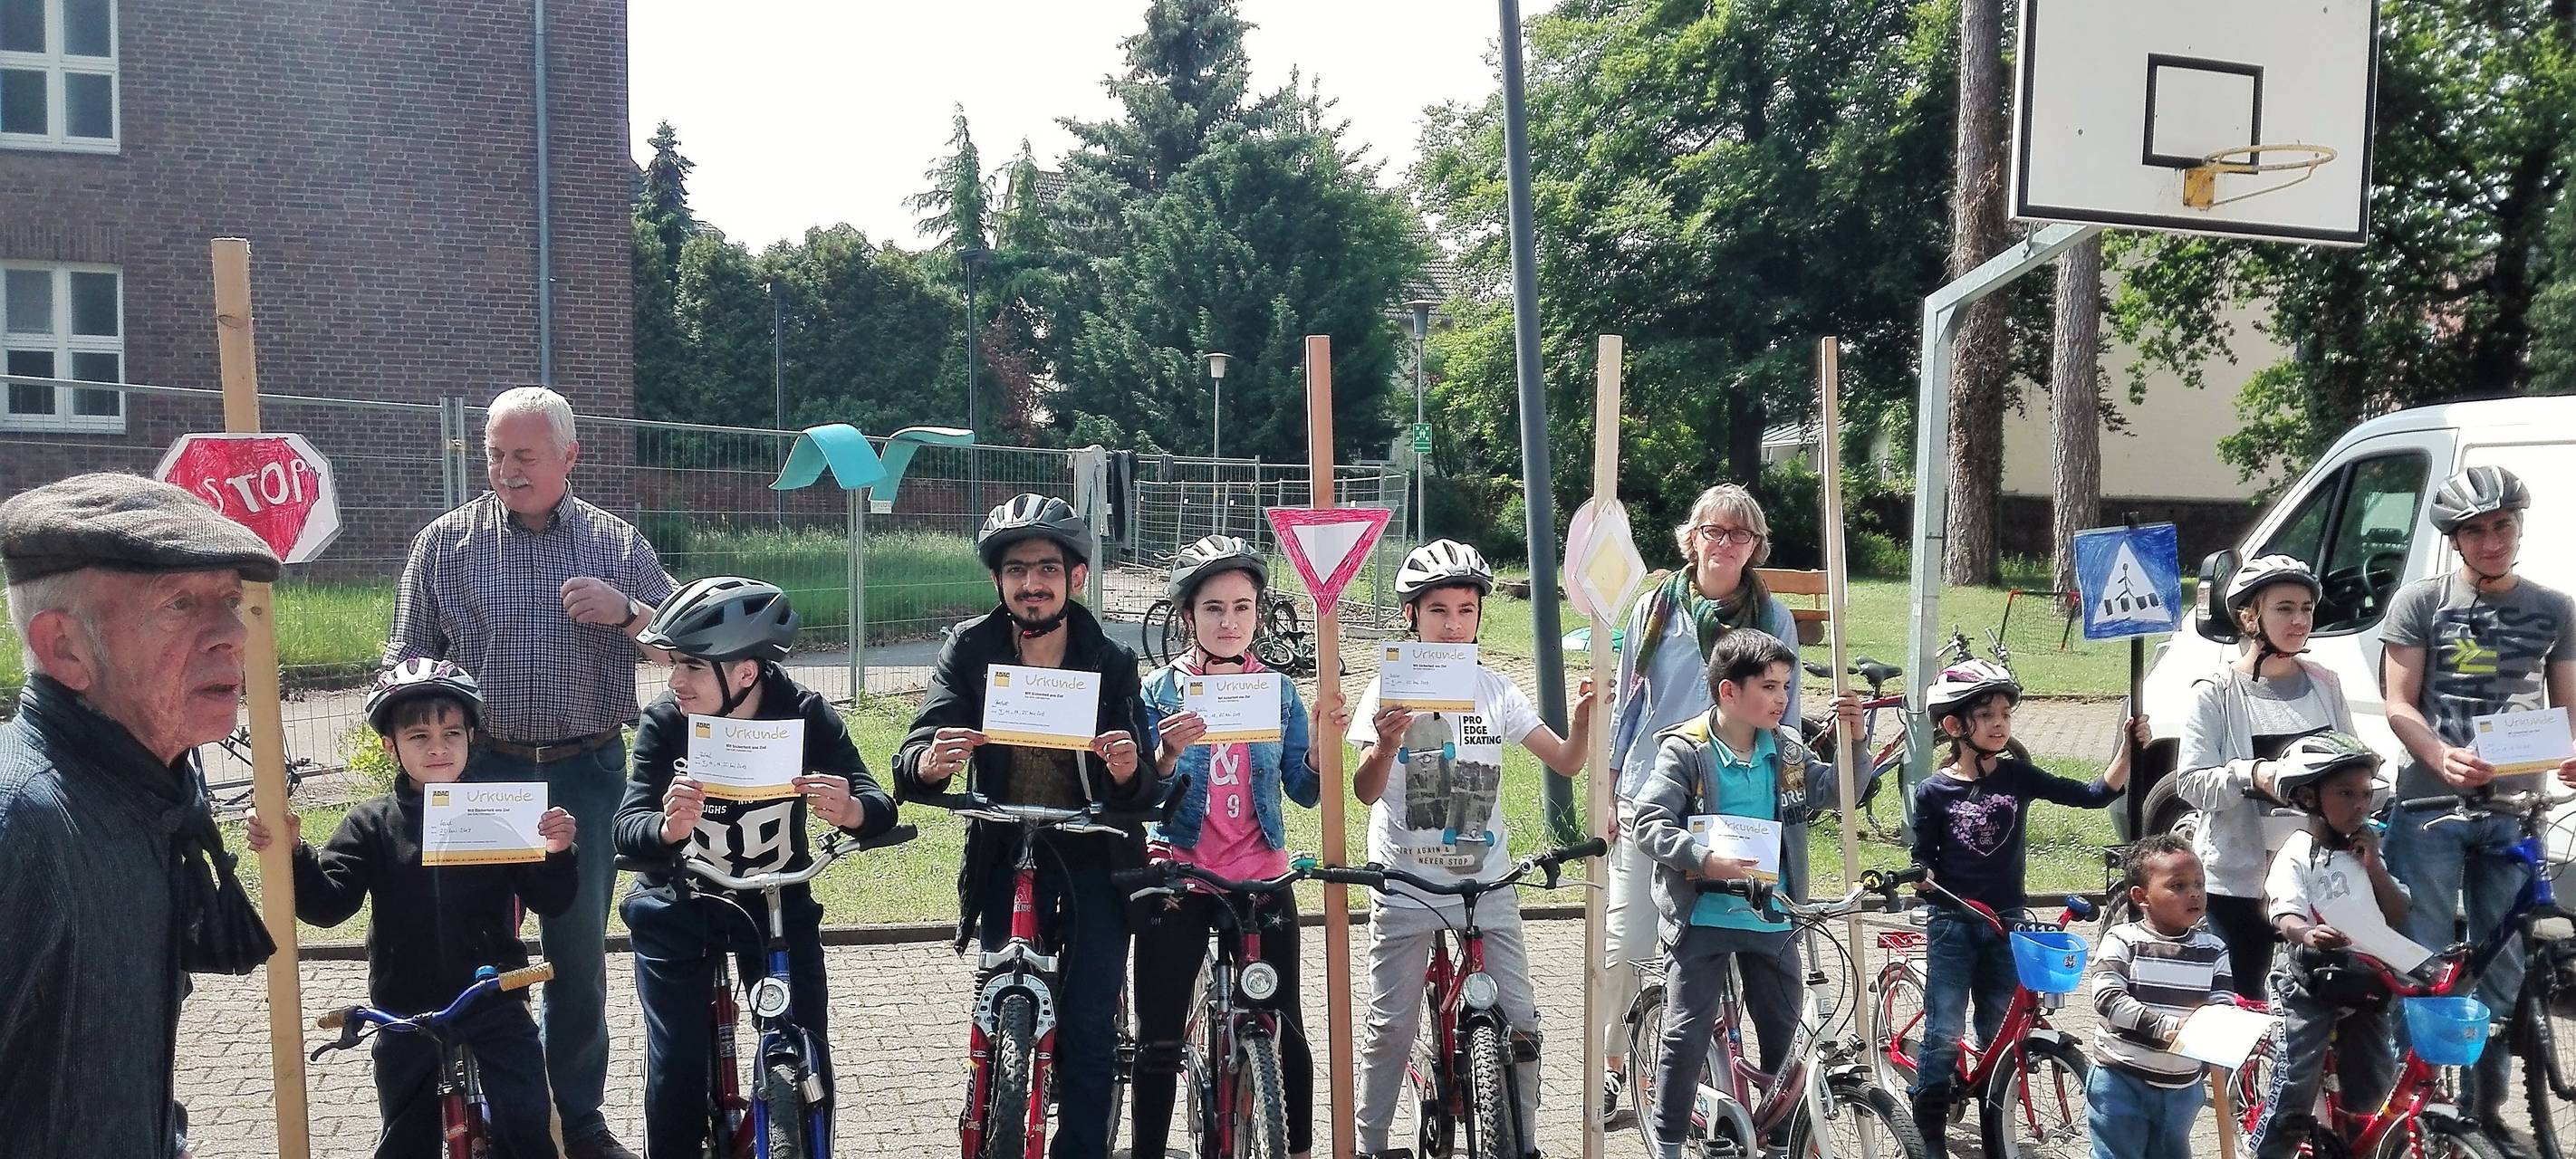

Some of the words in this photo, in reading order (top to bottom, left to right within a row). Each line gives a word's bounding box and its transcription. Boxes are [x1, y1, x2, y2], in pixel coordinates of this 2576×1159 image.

[202, 458, 305, 514] STOP
[1413, 648, 1466, 660] Urkunde
[1025, 675, 1087, 689] Urkunde
[1216, 679, 1269, 692] Urkunde
[1463, 715, 1483, 724] PRO
[726, 727, 790, 740] Urkunde
[1464, 725, 1488, 735] EDGE
[1464, 735, 1502, 745] SKATING
[467, 789, 534, 802] Urkunde
[1725, 820, 1769, 835] rkunde
[1399, 847, 1412, 855] TRY
[1417, 846, 1440, 855] AGAIN
[1418, 857, 1444, 865] NEVER
[1449, 857, 1467, 866] STOP
